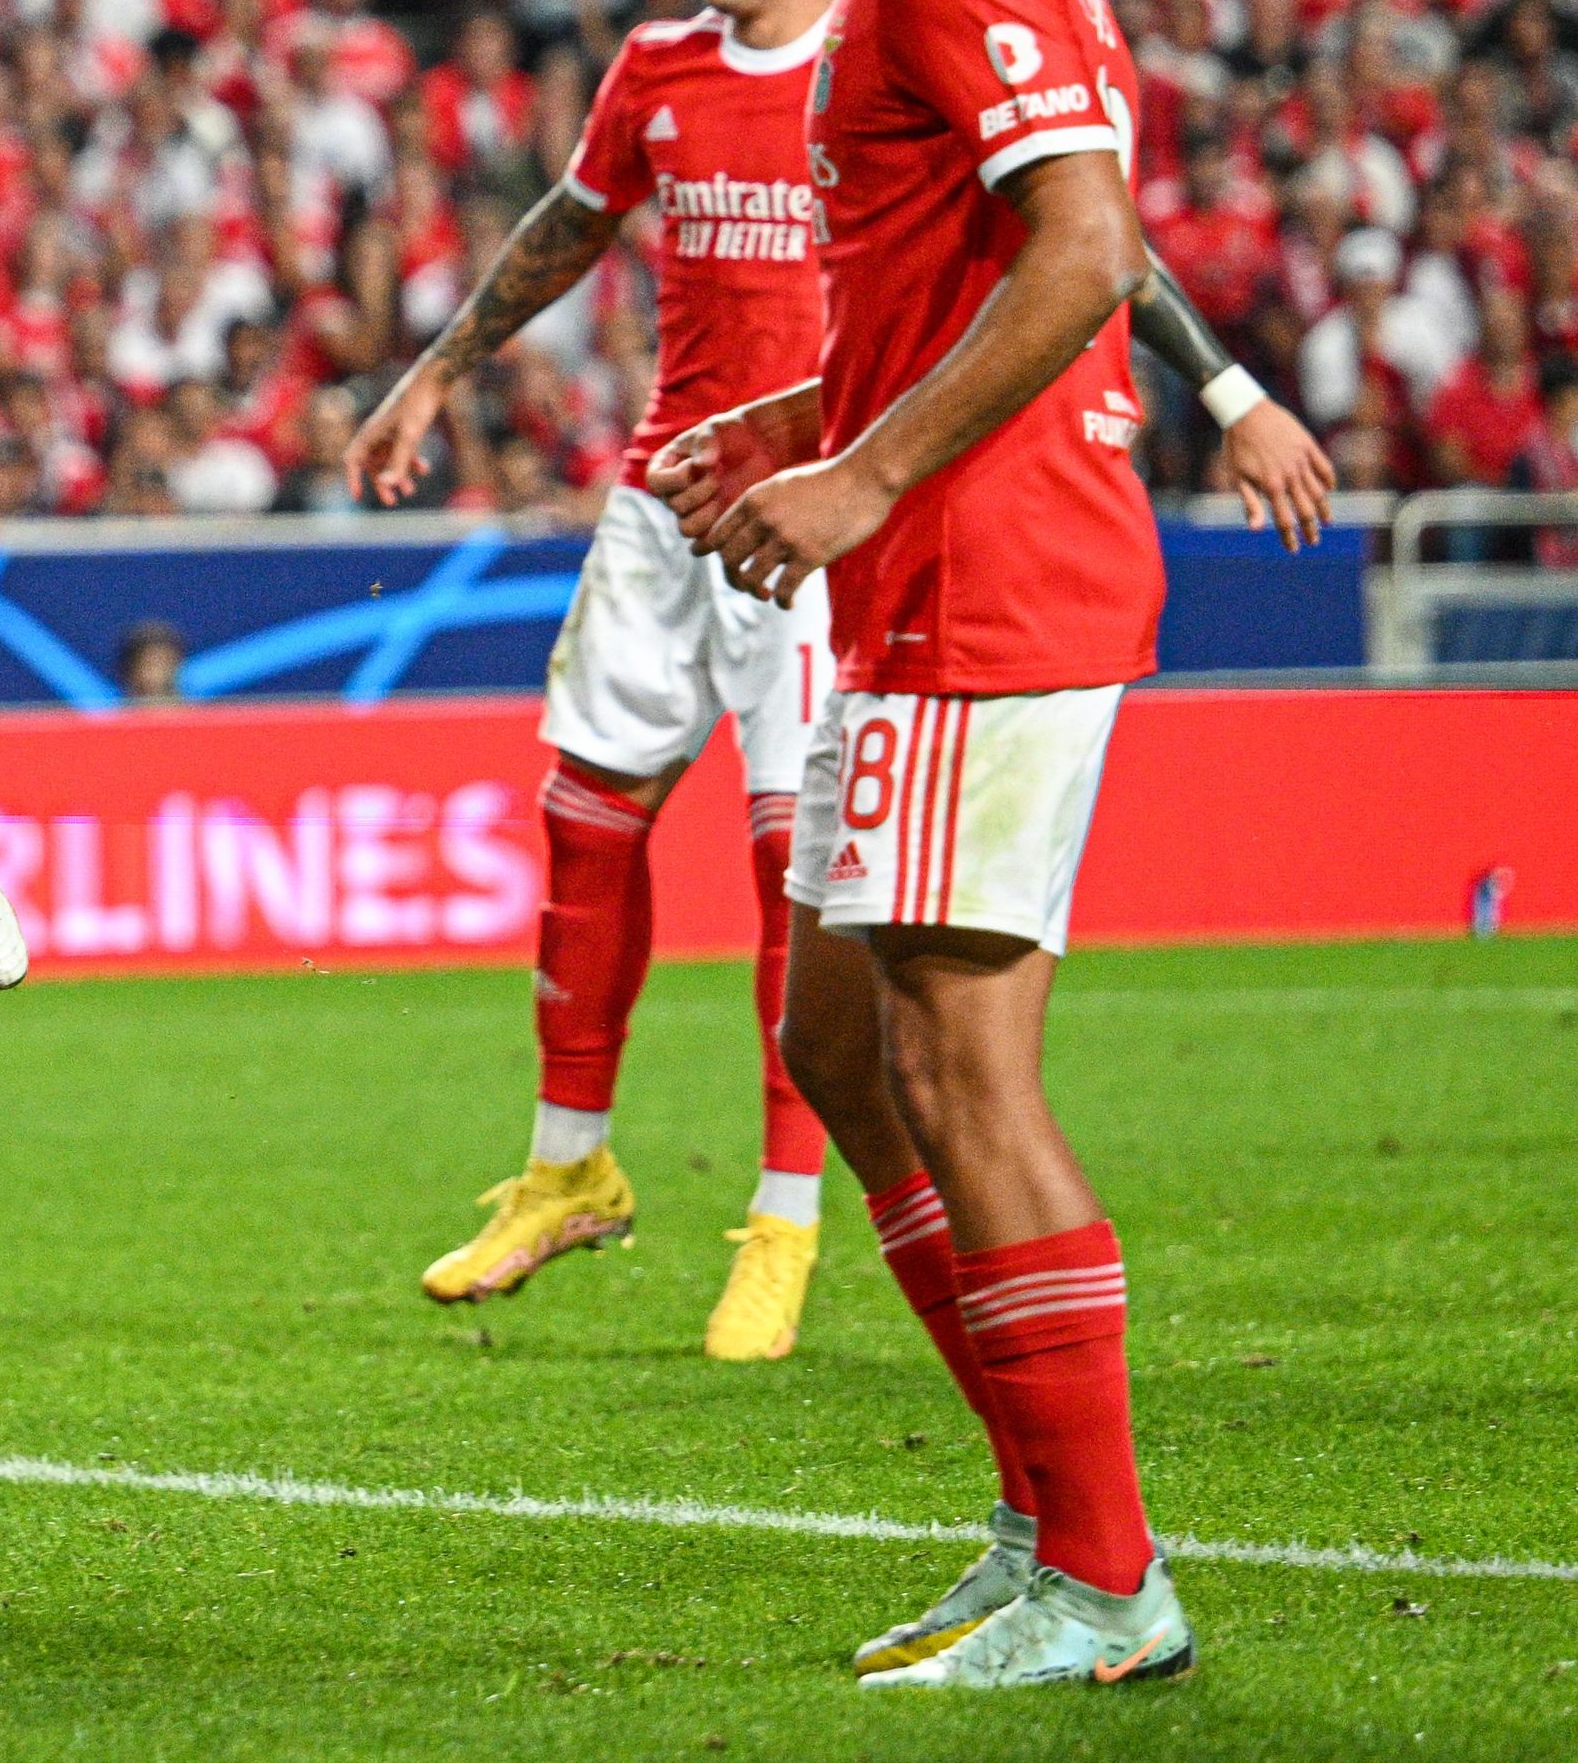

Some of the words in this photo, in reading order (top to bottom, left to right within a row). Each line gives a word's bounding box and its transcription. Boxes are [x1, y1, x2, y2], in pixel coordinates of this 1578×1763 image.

[978, 84, 1090, 141] BETANO
[656, 171, 813, 222] Emirate
[838, 717, 898, 830] 8
